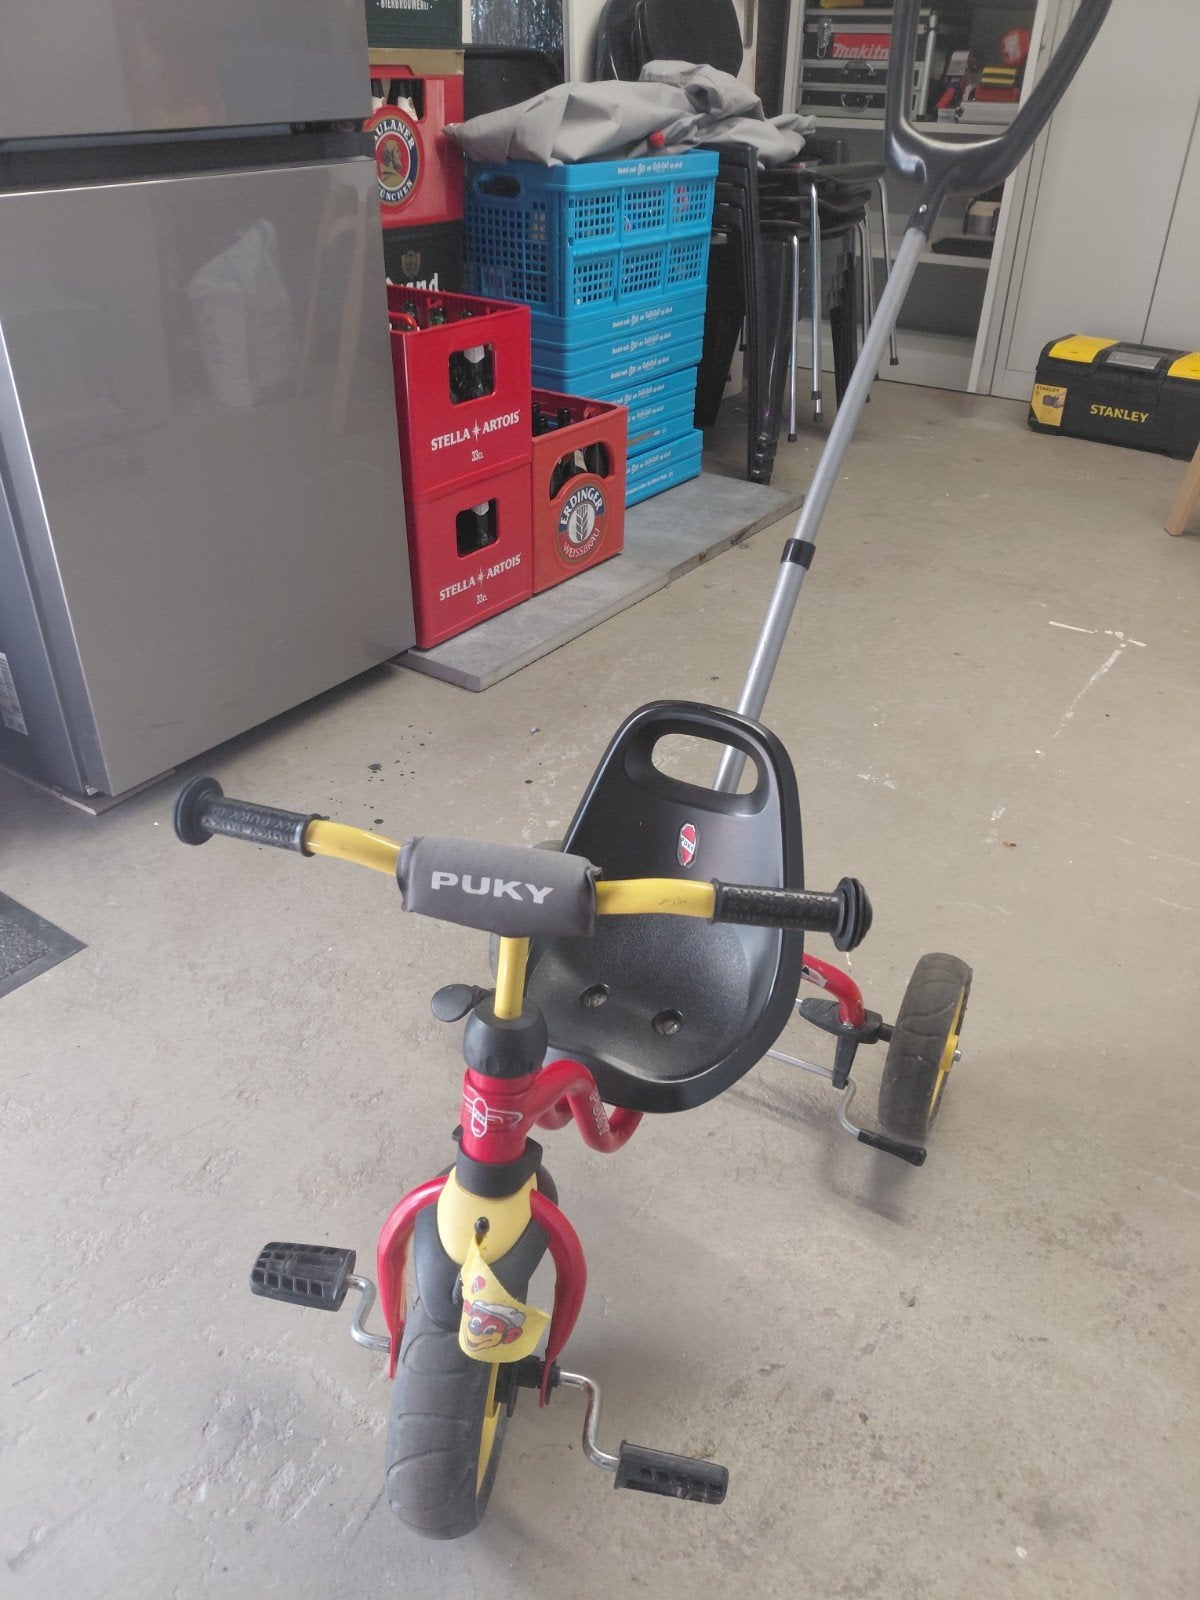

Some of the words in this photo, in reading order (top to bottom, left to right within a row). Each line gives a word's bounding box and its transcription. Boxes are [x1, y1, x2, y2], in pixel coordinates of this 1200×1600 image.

[430, 427, 471, 452] STELLA
[482, 411, 520, 435] ARTOIS
[1089, 404, 1149, 423] STANLEY
[560, 486, 603, 526] ERDINGER
[439, 575, 476, 602] STELLA
[486, 553, 522, 580] ARTOIS
[431, 870, 554, 904] PUKY
